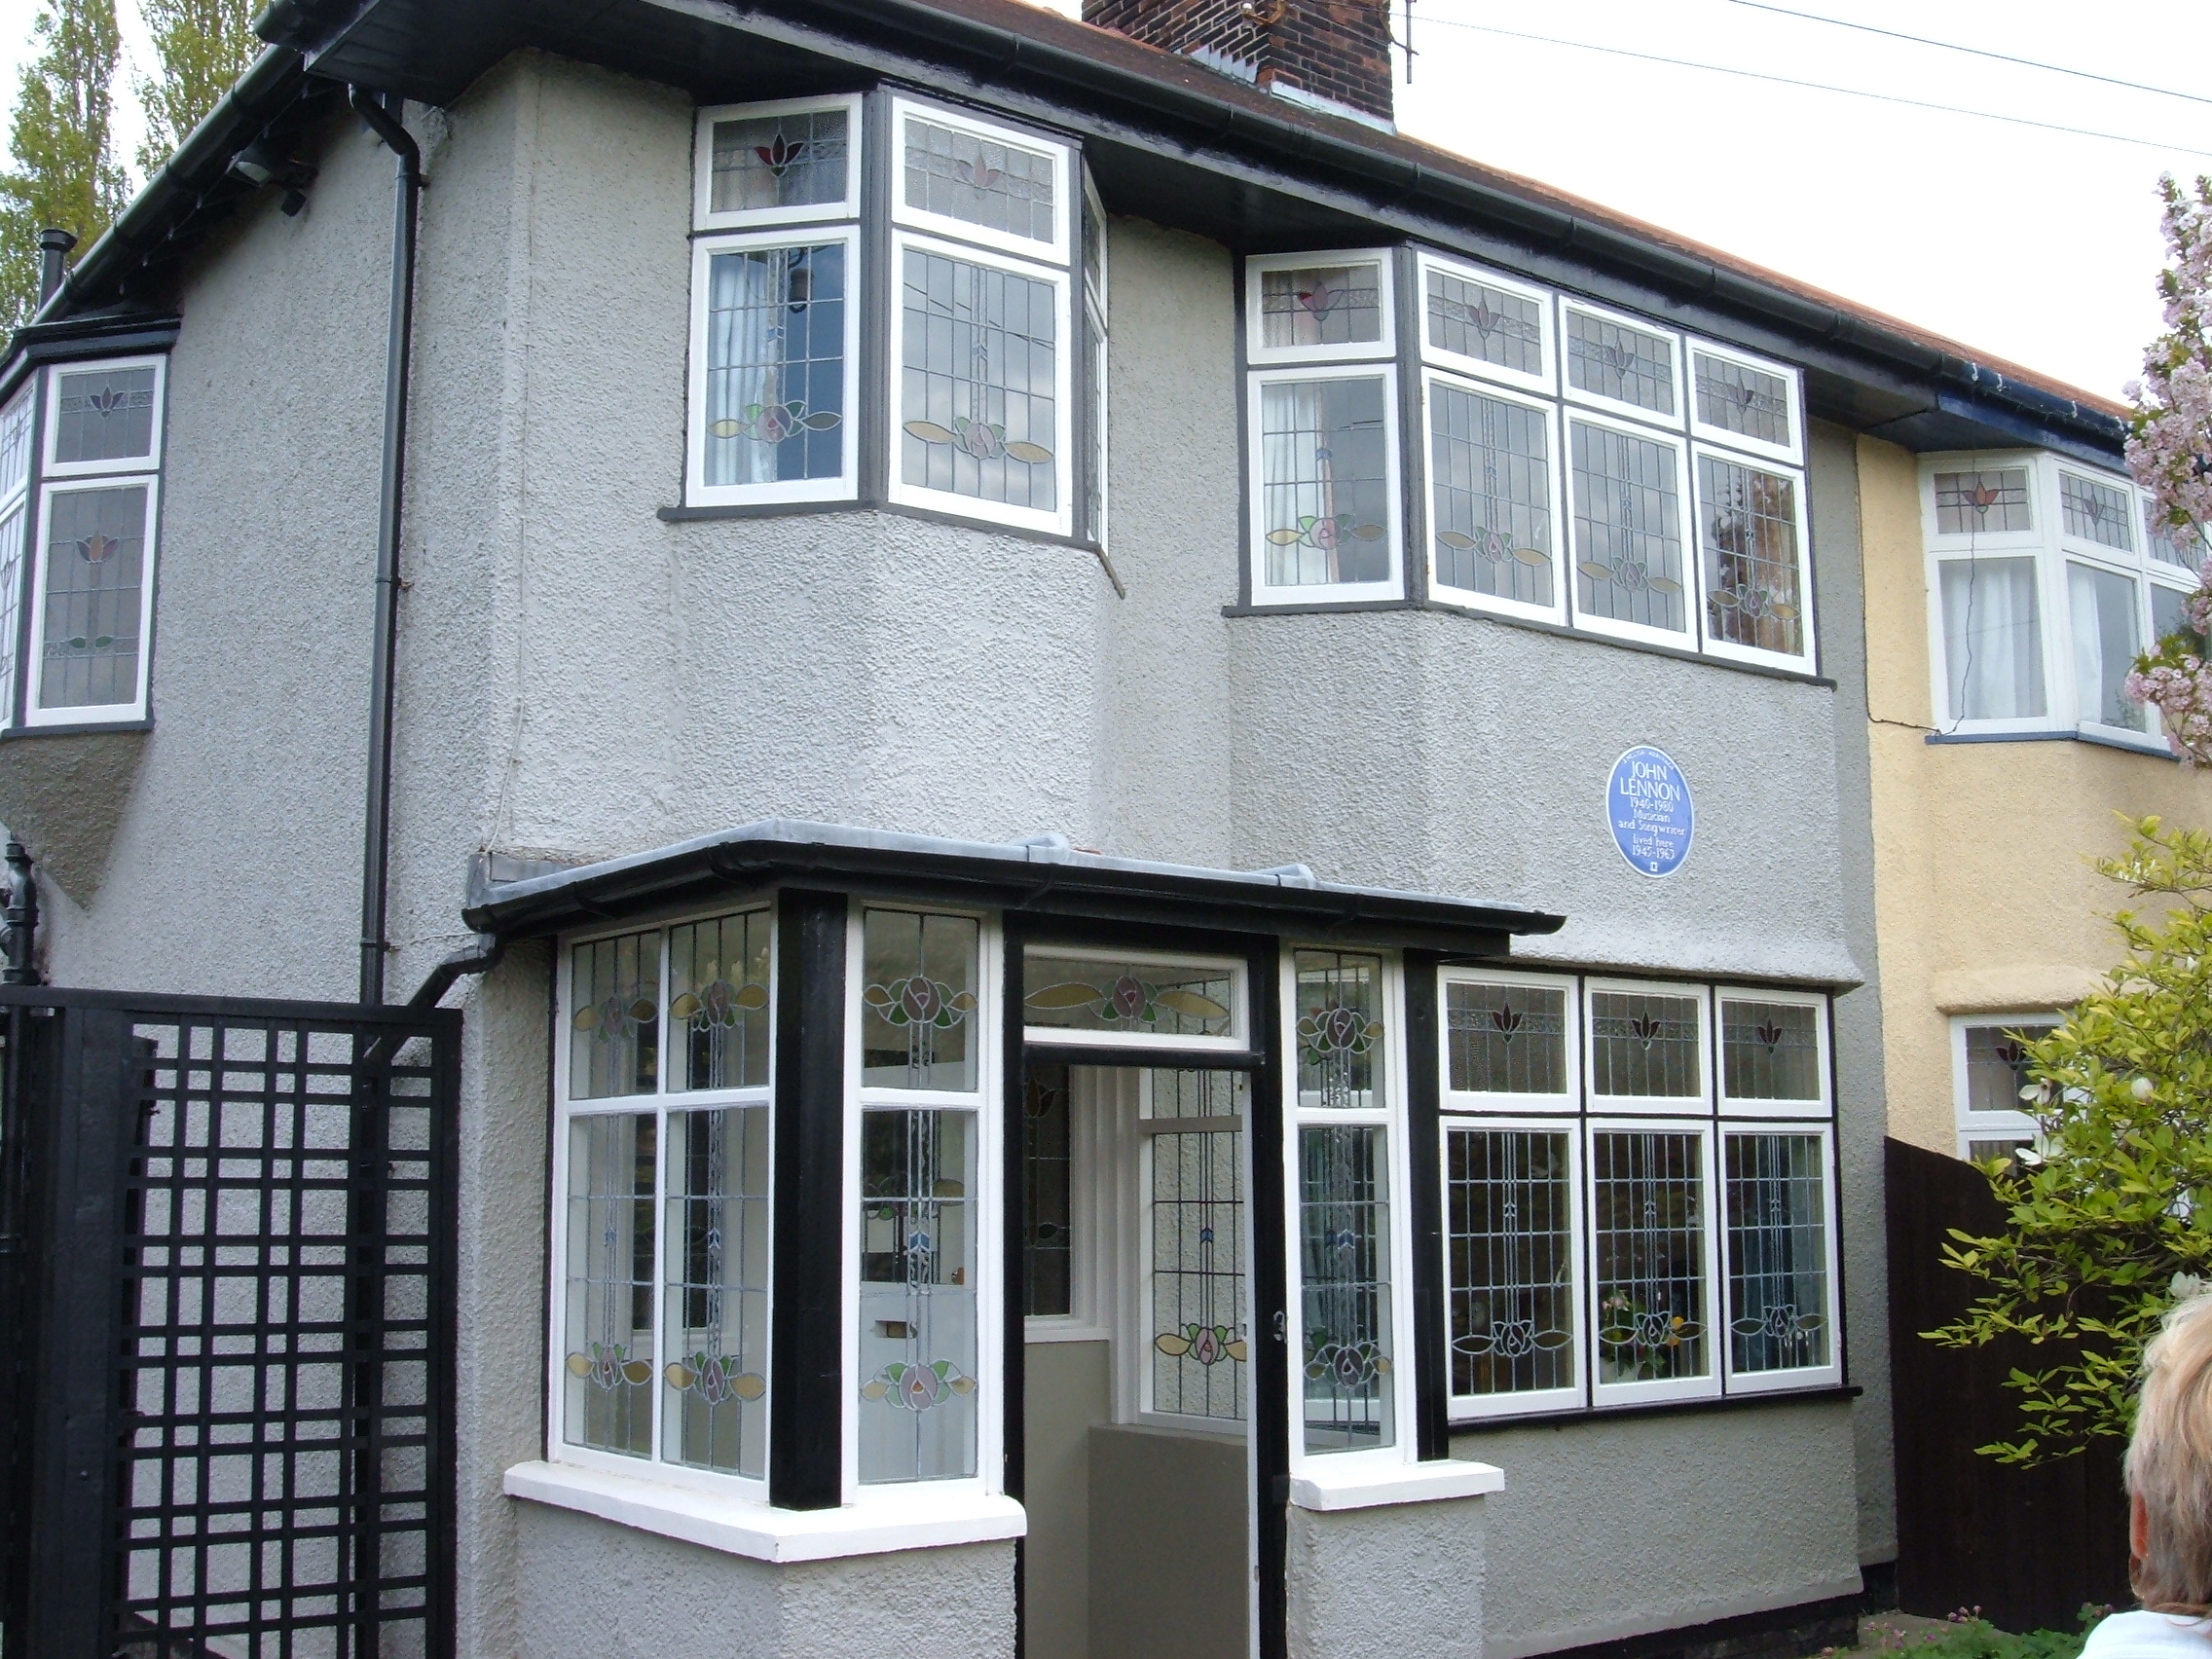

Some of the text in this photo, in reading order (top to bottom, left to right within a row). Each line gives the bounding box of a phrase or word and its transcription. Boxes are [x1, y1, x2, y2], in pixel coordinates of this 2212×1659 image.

[1632, 760, 1668, 781] JOHN
[1620, 777, 1679, 801] LENNON
[1630, 796, 1674, 813] 1940-1980
[1634, 808, 1671, 823] Musician
[1618, 819, 1636, 830] and
[1655, 836, 1674, 847] here
